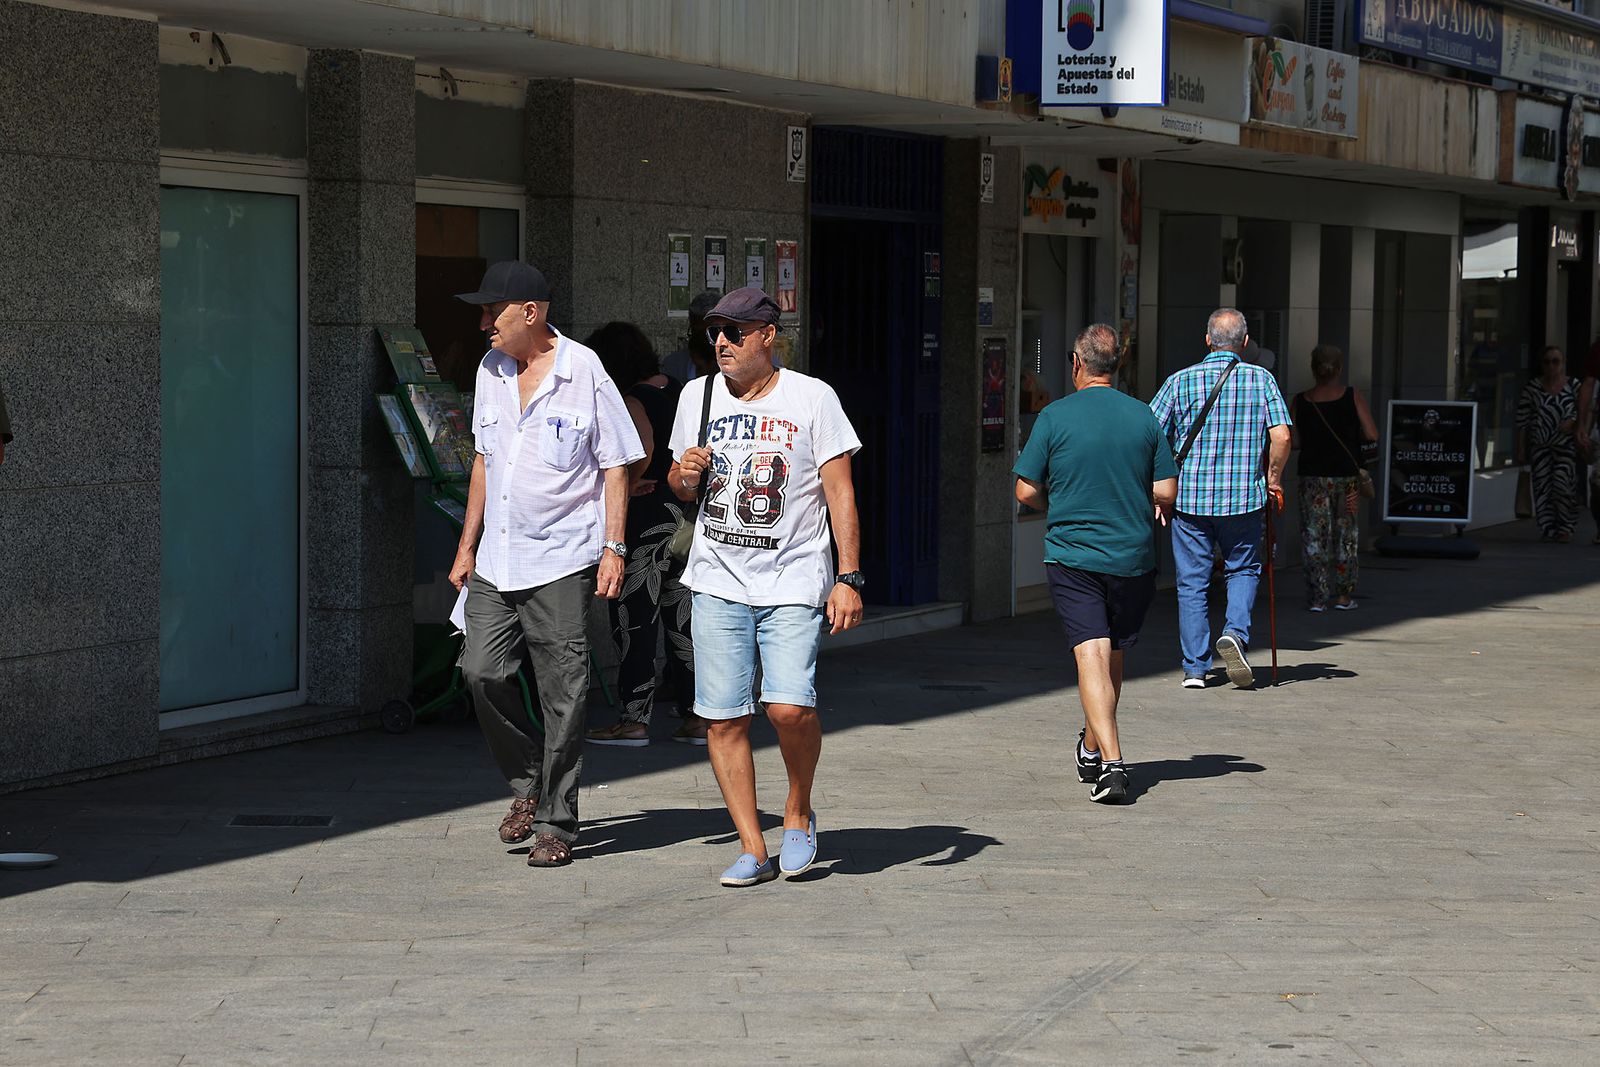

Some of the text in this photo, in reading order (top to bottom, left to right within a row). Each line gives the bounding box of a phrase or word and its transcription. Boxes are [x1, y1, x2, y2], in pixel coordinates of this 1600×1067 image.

[1396, 0, 1494, 42] ABOGADOS
[1057, 53, 1117, 68] Loterías y
[1058, 67, 1135, 82] Apuestas del
[1057, 82, 1098, 95] Estado
[1178, 74, 1205, 105] Estado
[707, 413, 799, 451] ISTRICT
[1403, 482, 1456, 494] COOKIES
[727, 535, 768, 547] CENTRAL
